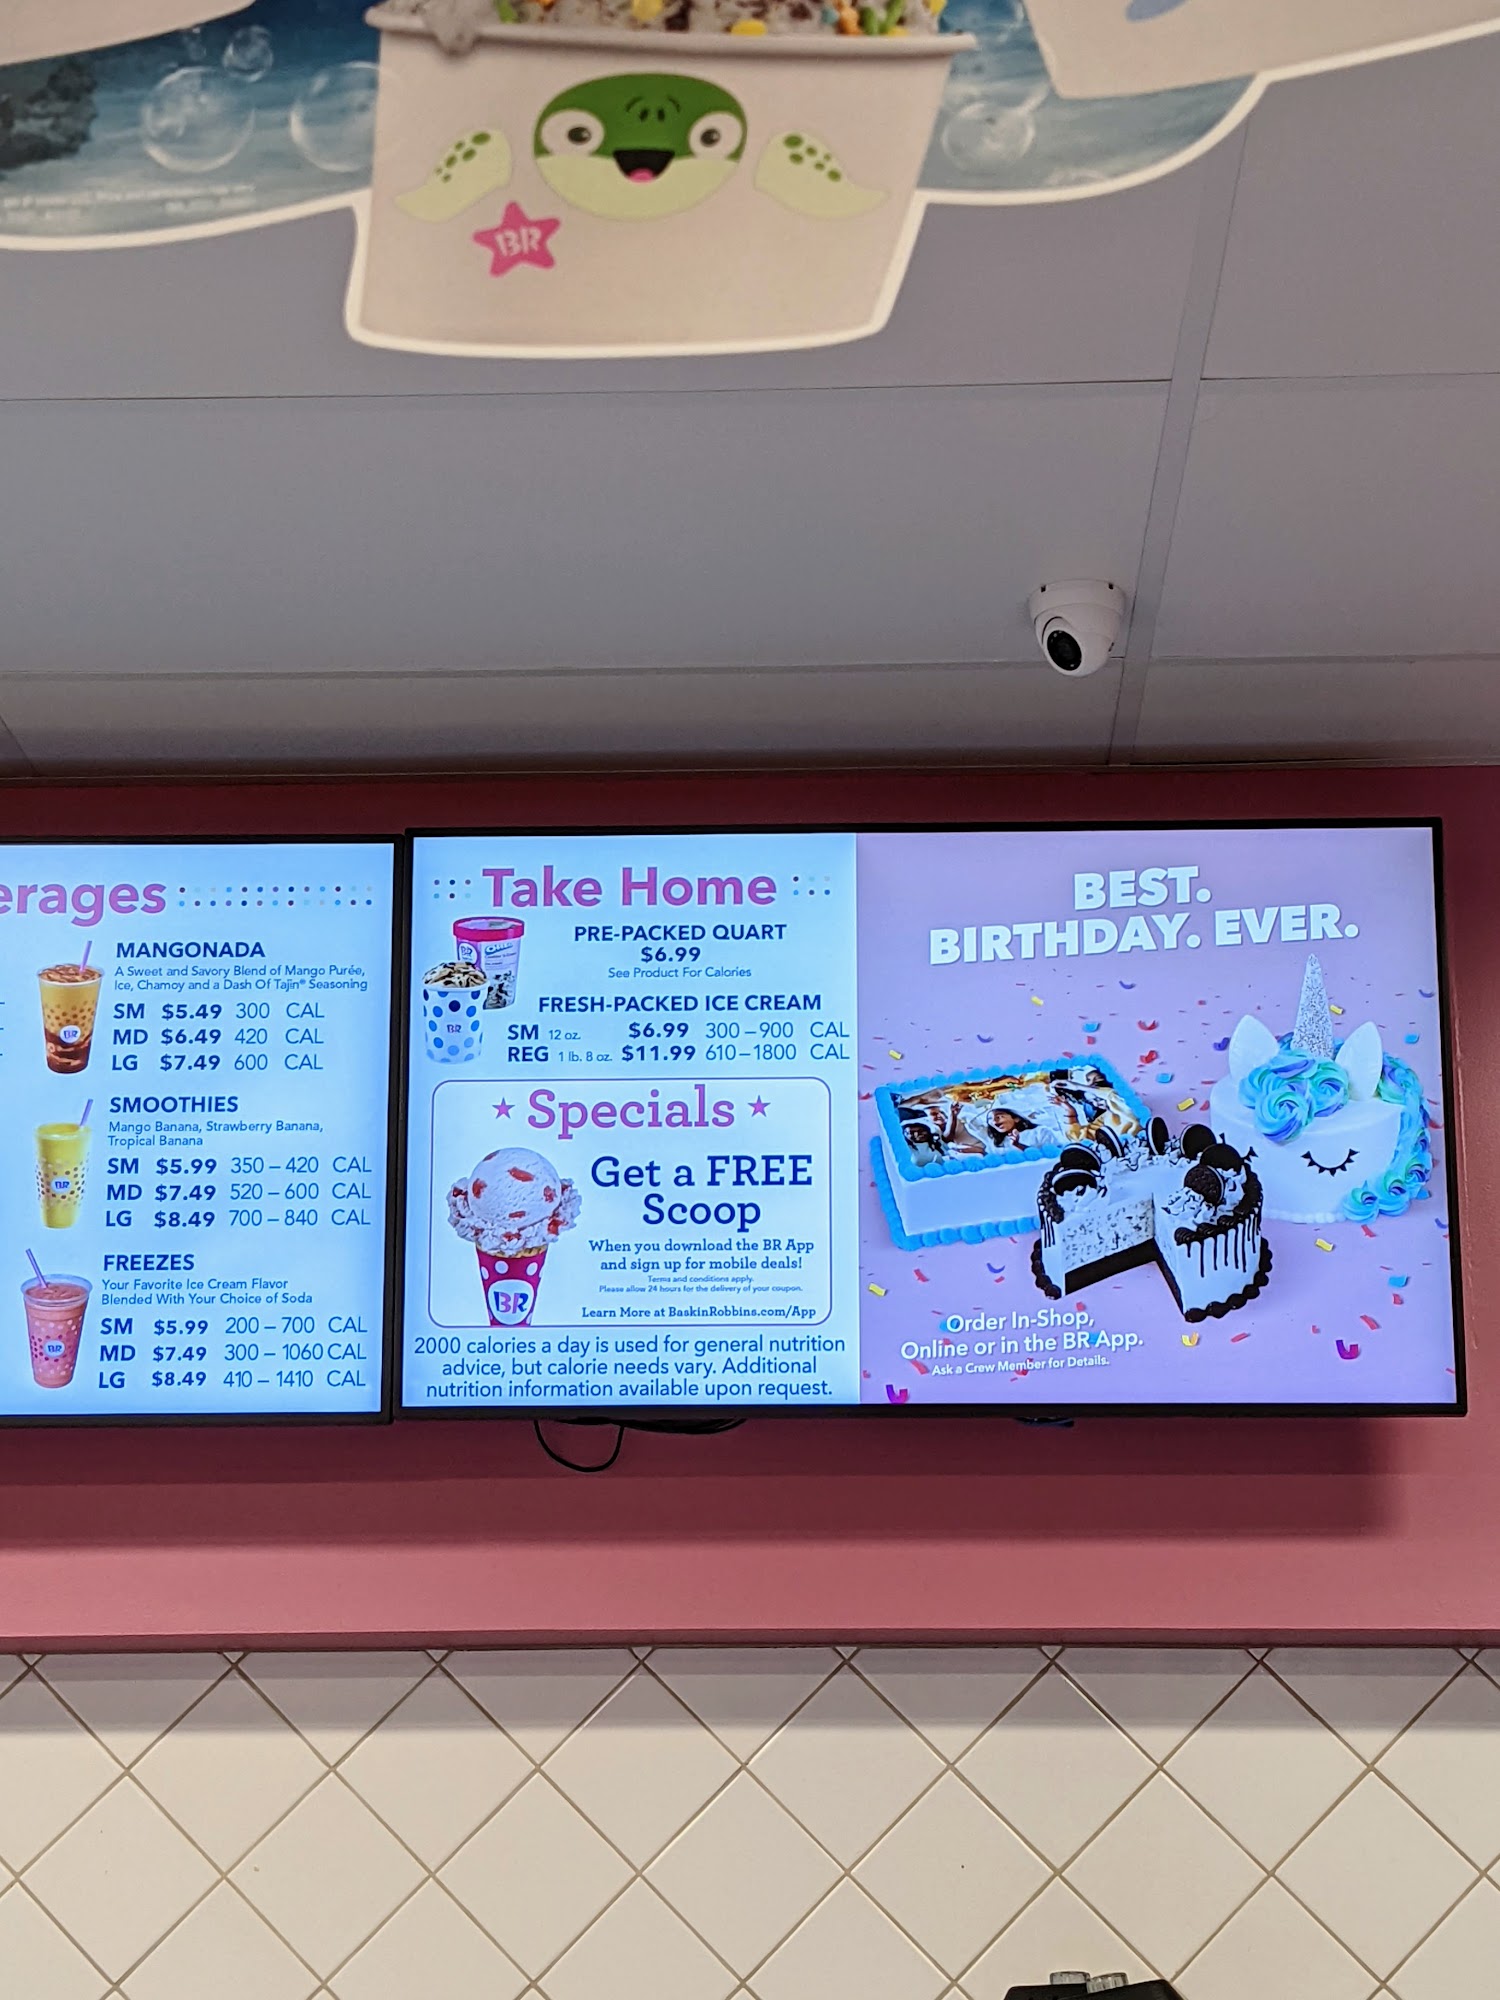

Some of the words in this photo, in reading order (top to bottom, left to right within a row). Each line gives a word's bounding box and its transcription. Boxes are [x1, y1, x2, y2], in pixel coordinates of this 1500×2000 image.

[495, 226, 541, 257] BR
[482, 865, 602, 908] Take
[622, 866, 777, 906] Home
[1074, 866, 1212, 910] BEST.
[574, 925, 706, 942] PRE-PACKED
[712, 924, 787, 940] QUART
[929, 912, 1201, 965] BIRTHDAY.
[1215, 904, 1359, 946] EVER.
[116, 942, 266, 958] MANGONADA
[641, 946, 701, 963] $6.99
[114, 966, 124, 976] A
[127, 966, 163, 977] Sweet
[166, 964, 188, 976] and
[191, 965, 230, 979] Savory
[233, 964, 267, 976] Blend
[269, 964, 282, 976] of
[284, 964, 326, 980] Mango
[608, 967, 630, 978] See
[633, 966, 679, 978] Product
[682, 966, 703, 978] For
[704, 966, 752, 978] Calories
[113, 1003, 145, 1019] SM
[161, 1003, 222, 1021] $5.49
[236, 1002, 270, 1019] 300
[286, 1002, 325, 1019] CAL
[539, 995, 698, 1012] FRESH-PACKED
[706, 995, 739, 1011] ICE
[744, 994, 821, 1011] CREAM
[113, 1029, 148, 1045] MD
[160, 1028, 222, 1046] $6.49
[234, 1028, 268, 1044] 420
[285, 1028, 324, 1044] CAL
[507, 1024, 539, 1041] SM
[549, 1029, 562, 1040] 12
[564, 1032, 581, 1040] oz.
[628, 1022, 689, 1039] $6.99
[810, 1021, 850, 1038] CAL
[112, 1054, 138, 1071] LG
[160, 1053, 220, 1072] $7.49
[234, 1054, 268, 1070] 600
[284, 1054, 323, 1070] CAL
[508, 1046, 549, 1062] REG
[559, 1052, 563, 1061] 1
[568, 1051, 582, 1061] lb.
[586, 1052, 593, 1061] 8
[621, 1044, 696, 1062] $11.99
[810, 1043, 850, 1060] CAL
[109, 1096, 238, 1113] SMOOTHIES
[528, 1084, 735, 1140] Specials
[109, 1121, 151, 1135] Mango
[155, 1120, 202, 1134] Banana,
[206, 1120, 272, 1134] Strawberry
[276, 1120, 323, 1133] Banana,
[107, 1157, 139, 1174] SM
[156, 1157, 217, 1176] $5.99
[332, 1156, 372, 1173] CAL
[591, 1156, 661, 1188] Get
[673, 1165, 695, 1187] a
[707, 1154, 812, 1186] FREE
[106, 1184, 142, 1200] MD
[154, 1184, 216, 1202] $7.49
[332, 1182, 372, 1199] CAL
[106, 1210, 132, 1227] LG
[154, 1210, 215, 1229] $8.49
[331, 1208, 371, 1226] CAL
[642, 1193, 761, 1233] Scoop
[588, 1238, 632, 1252] When
[634, 1243, 660, 1255] you
[664, 1238, 733, 1252] download
[736, 1238, 759, 1251] the
[762, 1238, 782, 1251] BR
[785, 1238, 814, 1254] App
[104, 1254, 194, 1271] FREEZES
[600, 1256, 627, 1270] and
[630, 1258, 660, 1273] sign
[663, 1261, 682, 1273] up
[685, 1256, 706, 1270] for
[709, 1256, 757, 1270] mobile
[761, 1256, 802, 1269] deals!
[102, 1279, 130, 1290] Your
[133, 1278, 183, 1290] Favorite
[186, 1278, 204, 1290] Ice
[207, 1278, 247, 1290] Cream
[251, 1277, 288, 1289] Flavor
[494, 1291, 529, 1314] BR
[582, 1307, 616, 1318] Learn
[620, 1306, 651, 1318] More
[654, 1308, 666, 1317] at
[668, 1305, 816, 1319] BaskinRobbins.com/App
[100, 1318, 133, 1335] SM
[154, 1319, 208, 1336] $5.99
[328, 1316, 368, 1333] CAL
[946, 1312, 1007, 1332] Order
[1012, 1308, 1095, 1330] In-Shop,
[100, 1344, 136, 1362] MD
[152, 1345, 207, 1363] $7.49
[327, 1343, 367, 1360] CAL
[414, 1336, 461, 1354] 2000
[466, 1335, 536, 1354] calories
[541, 1341, 551, 1354] a
[557, 1335, 590, 1358] day
[596, 1336, 609, 1353] is
[615, 1334, 658, 1353] used
[663, 1334, 690, 1352] for
[694, 1334, 763, 1357] general
[769, 1334, 845, 1352] nutrition
[901, 1339, 968, 1359] Online
[974, 1341, 996, 1355] or
[1001, 1337, 1019, 1354] in
[1024, 1333, 1057, 1352] the
[1063, 1331, 1090, 1350] BR
[1095, 1329, 1144, 1351] App.
[442, 1357, 505, 1378] advice,
[512, 1357, 542, 1375] but
[547, 1356, 608, 1375] calorie
[614, 1356, 669, 1374] needs
[674, 1362, 716, 1379] vary.
[722, 1355, 816, 1374] Additional
[932, 1364, 953, 1376] Ask
[965, 1362, 995, 1374] Crew
[998, 1359, 1046, 1372] Member
[1048, 1357, 1065, 1368] for
[1067, 1355, 1111, 1367] Details.
[98, 1371, 125, 1389] LG
[152, 1370, 206, 1388] $8.49
[326, 1370, 366, 1387] CAL
[426, 1380, 502, 1398] nutrition
[508, 1378, 613, 1397] information
[618, 1378, 699, 1396] available
[705, 1383, 752, 1401] upon
[758, 1380, 832, 1401] request.
